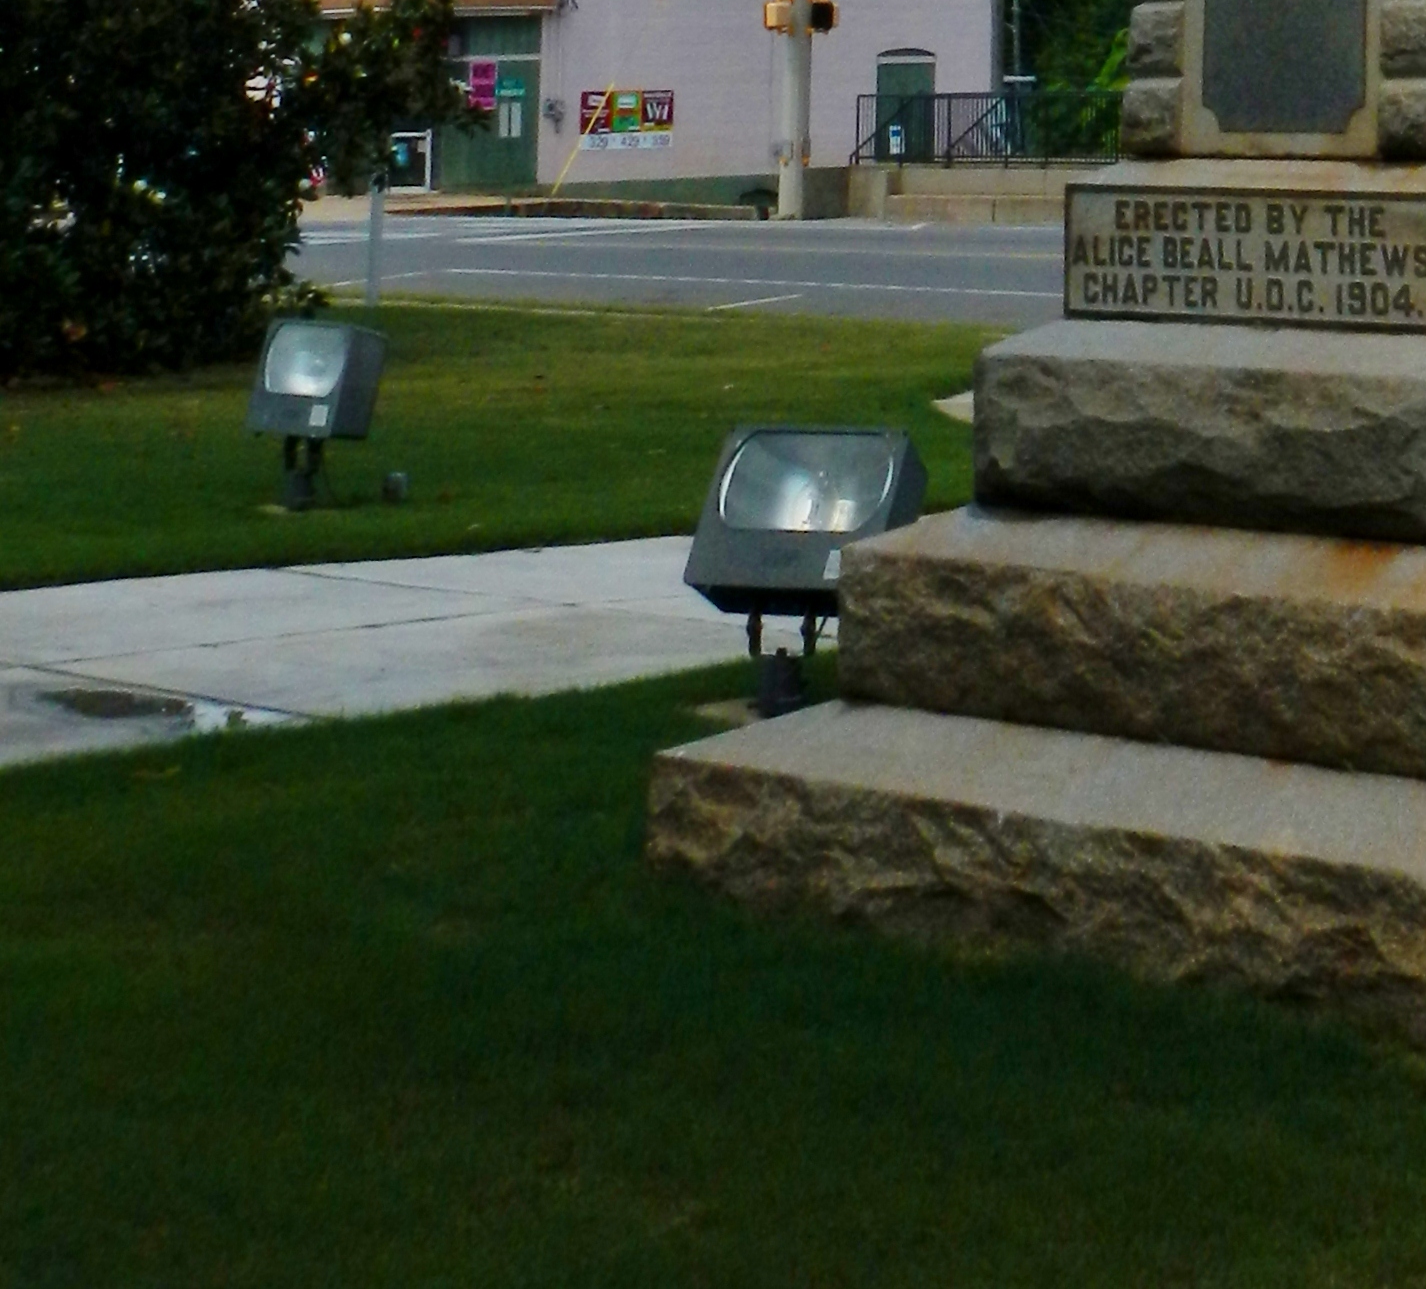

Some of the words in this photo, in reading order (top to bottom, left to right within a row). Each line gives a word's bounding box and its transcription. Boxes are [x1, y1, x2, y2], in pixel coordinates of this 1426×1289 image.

[1114, 199, 1252, 234] ERECTED
[1266, 203, 1309, 235] BY
[1324, 205, 1386, 238] THE
[1072, 235, 1152, 268] ALICE
[1162, 236, 1253, 272] BEALL
[1083, 272, 1218, 308] CHAPTER
